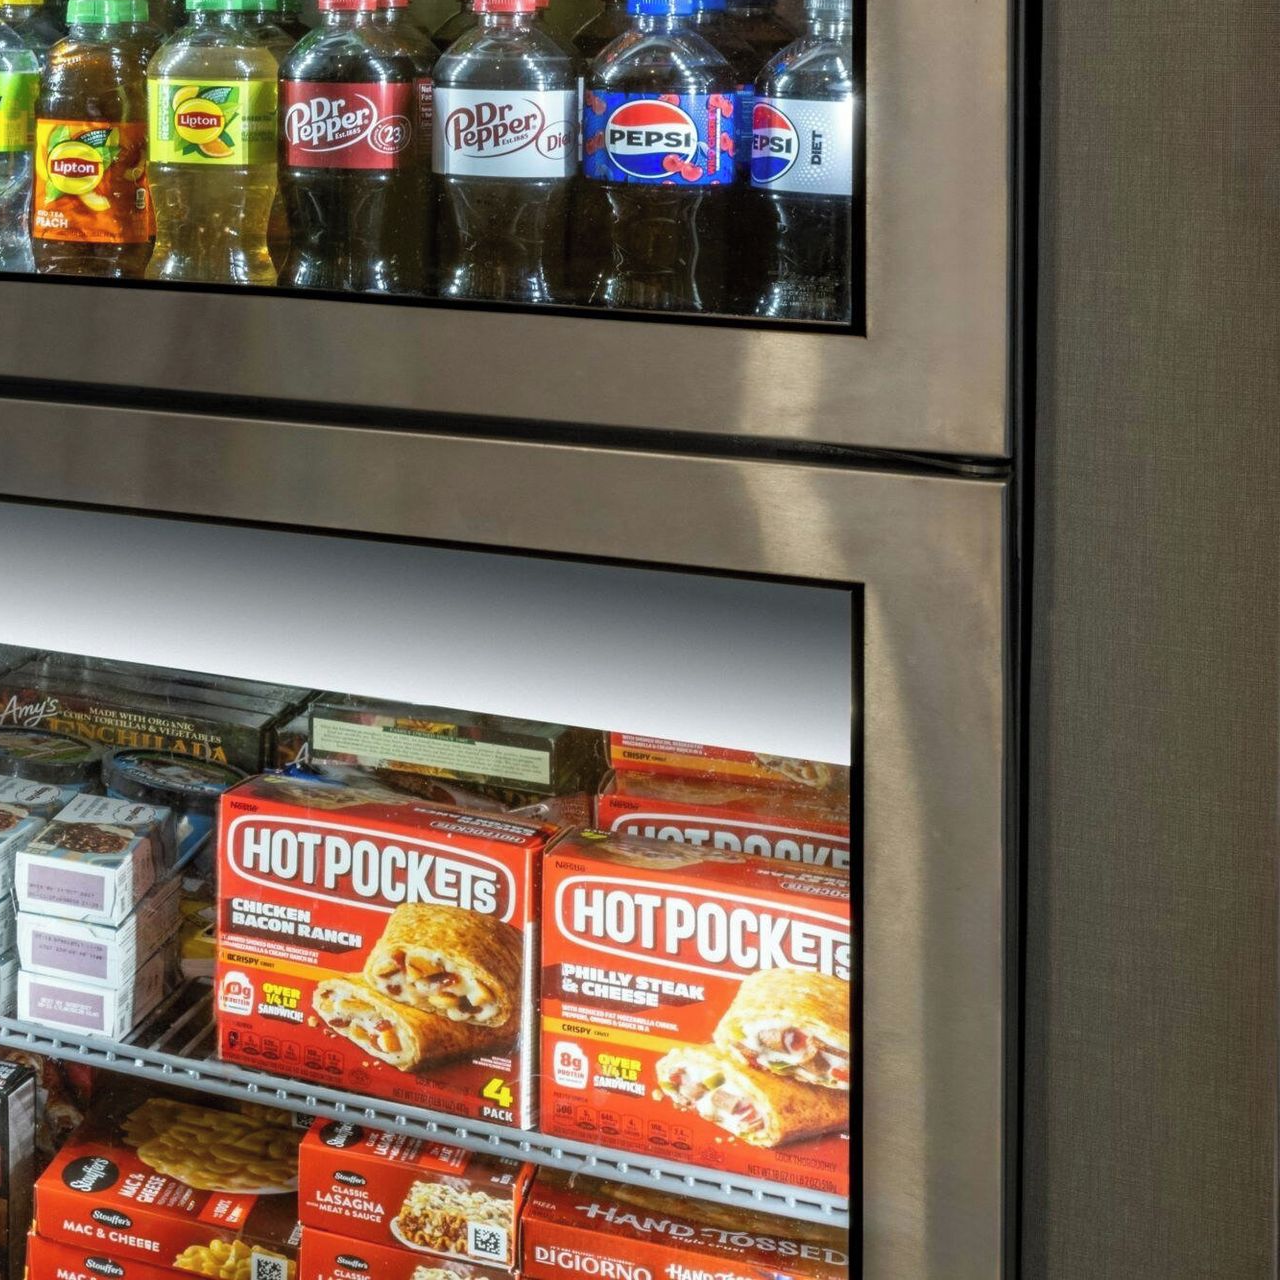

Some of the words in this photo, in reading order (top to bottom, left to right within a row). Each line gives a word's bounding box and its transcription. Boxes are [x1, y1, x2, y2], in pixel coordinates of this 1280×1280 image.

[180, 115, 219, 128] Lipton
[312, 97, 347, 122] Dr
[476, 102, 513, 127] Dr
[289, 103, 369, 146] Pepper
[384, 127, 401, 144] 23
[449, 108, 538, 151] Pepper
[610, 129, 692, 148] PEPSI
[752, 133, 792, 154] EPSI
[810, 129, 823, 166] DIET
[53, 161, 95, 175] Lipton
[89, 706, 118, 718] MADE
[119, 711, 146, 724] WITH
[148, 715, 195, 732] ORGANIC
[93, 715, 147, 731] TORTILLAS
[159, 725, 223, 744] VEGETABLES
[242, 825, 323, 886] HOT
[323, 832, 498, 916] POCKETS
[232, 897, 311, 924] CHICKEN
[573, 887, 663, 951] HOT
[232, 911, 296, 935] BACON
[297, 923, 363, 949] RANCH
[262, 982, 302, 1000] OVER
[561, 962, 634, 988] PHILLY
[635, 975, 706, 1001] STEAK
[562, 978, 579, 994] &
[581, 983, 660, 1008] CHEESE
[559, 1052, 583, 1071] 8g
[597, 1053, 642, 1071] OVER
[482, 1077, 514, 1109] 4
[483, 1106, 513, 1123] PACK
[70, 1157, 110, 1192] Stouffer's
[316, 1190, 385, 1216] LASAGNA
[331, 1184, 369, 1200] CLASSIC
[319, 1203, 344, 1216] MEAT
[351, 1209, 382, 1224] SAUCE
[532, 1200, 556, 1212] PIZZA
[92, 1210, 132, 1228] Stouffer's
[63, 1220, 93, 1237] MAC
[96, 1227, 106, 1238] &
[108, 1231, 161, 1253] CHEESE
